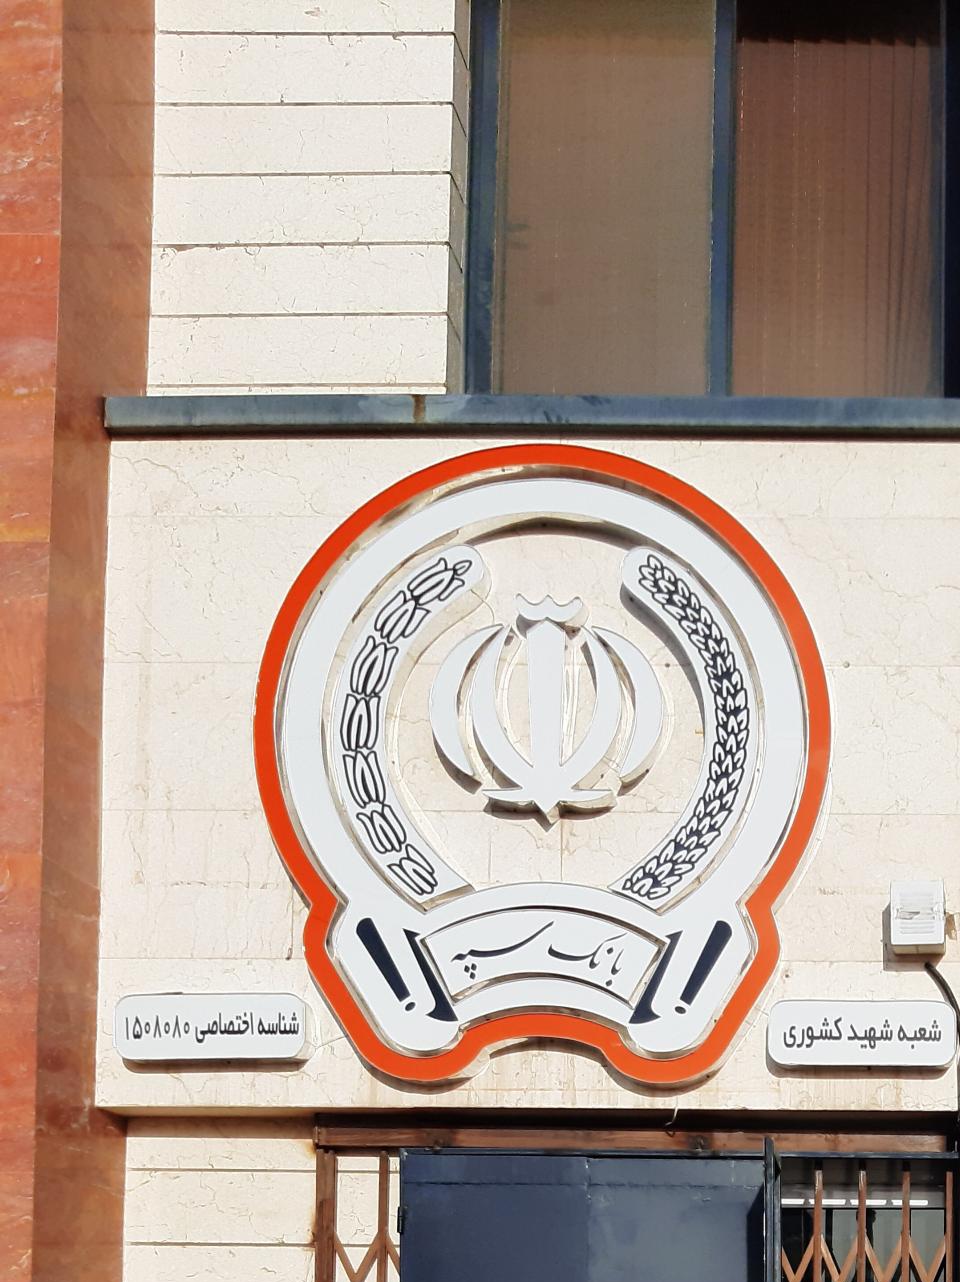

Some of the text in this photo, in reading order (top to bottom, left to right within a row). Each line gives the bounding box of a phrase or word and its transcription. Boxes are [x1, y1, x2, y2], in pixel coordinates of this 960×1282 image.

[450, 920, 629, 987] بانک سپه
[125, 1012, 299, 1043] شناسه اختصاصی ۱۵۰۸۰۸۰
[783, 1017, 942, 1050] شعبه شهید کشوری
